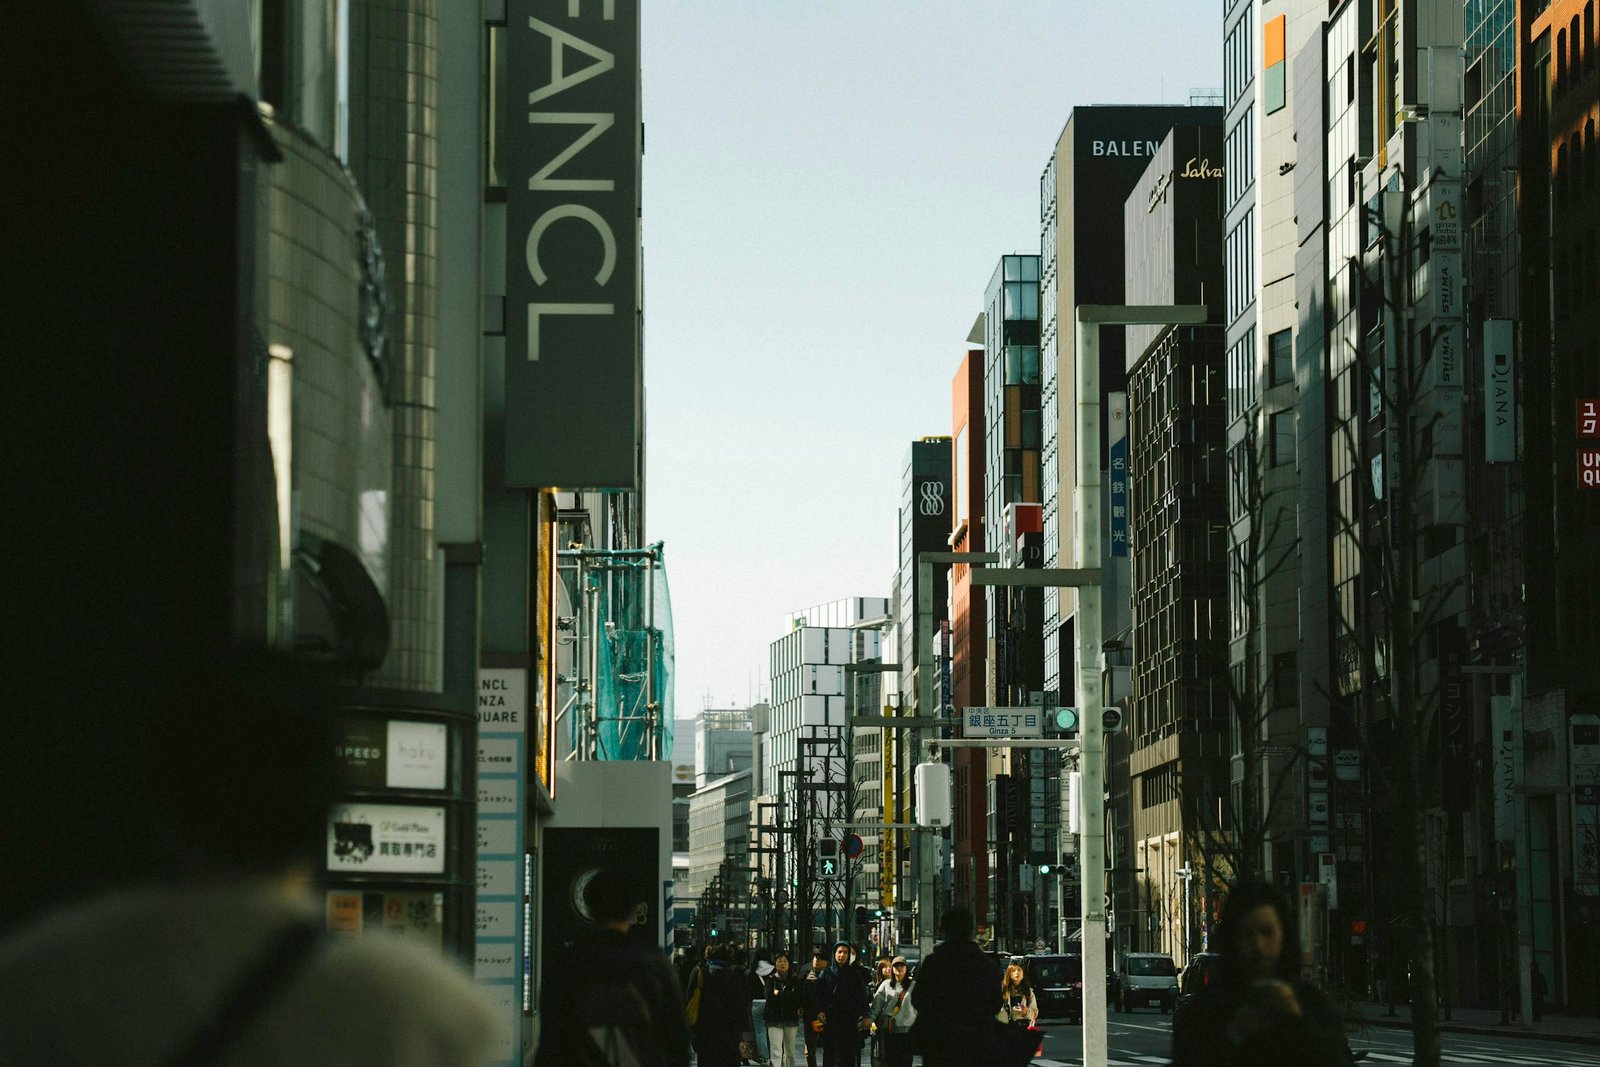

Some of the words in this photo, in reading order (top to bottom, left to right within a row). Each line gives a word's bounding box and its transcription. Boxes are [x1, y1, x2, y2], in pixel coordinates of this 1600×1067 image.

[1092, 140, 1159, 156] BALEN
[1180, 157, 1225, 179] Salva
[1441, 267, 1450, 313] SHIMA
[1442, 336, 1450, 383] SHIMA
[1494, 362, 1511, 427] DIANA
[1112, 457, 1125, 542] 名鉄観光
[479, 679, 509, 691] NCL
[969, 714, 1037, 728] 銀座五丁目
[989, 727, 1009, 735] Ginza
[1446, 683, 1463, 759] ヨシノヤ
